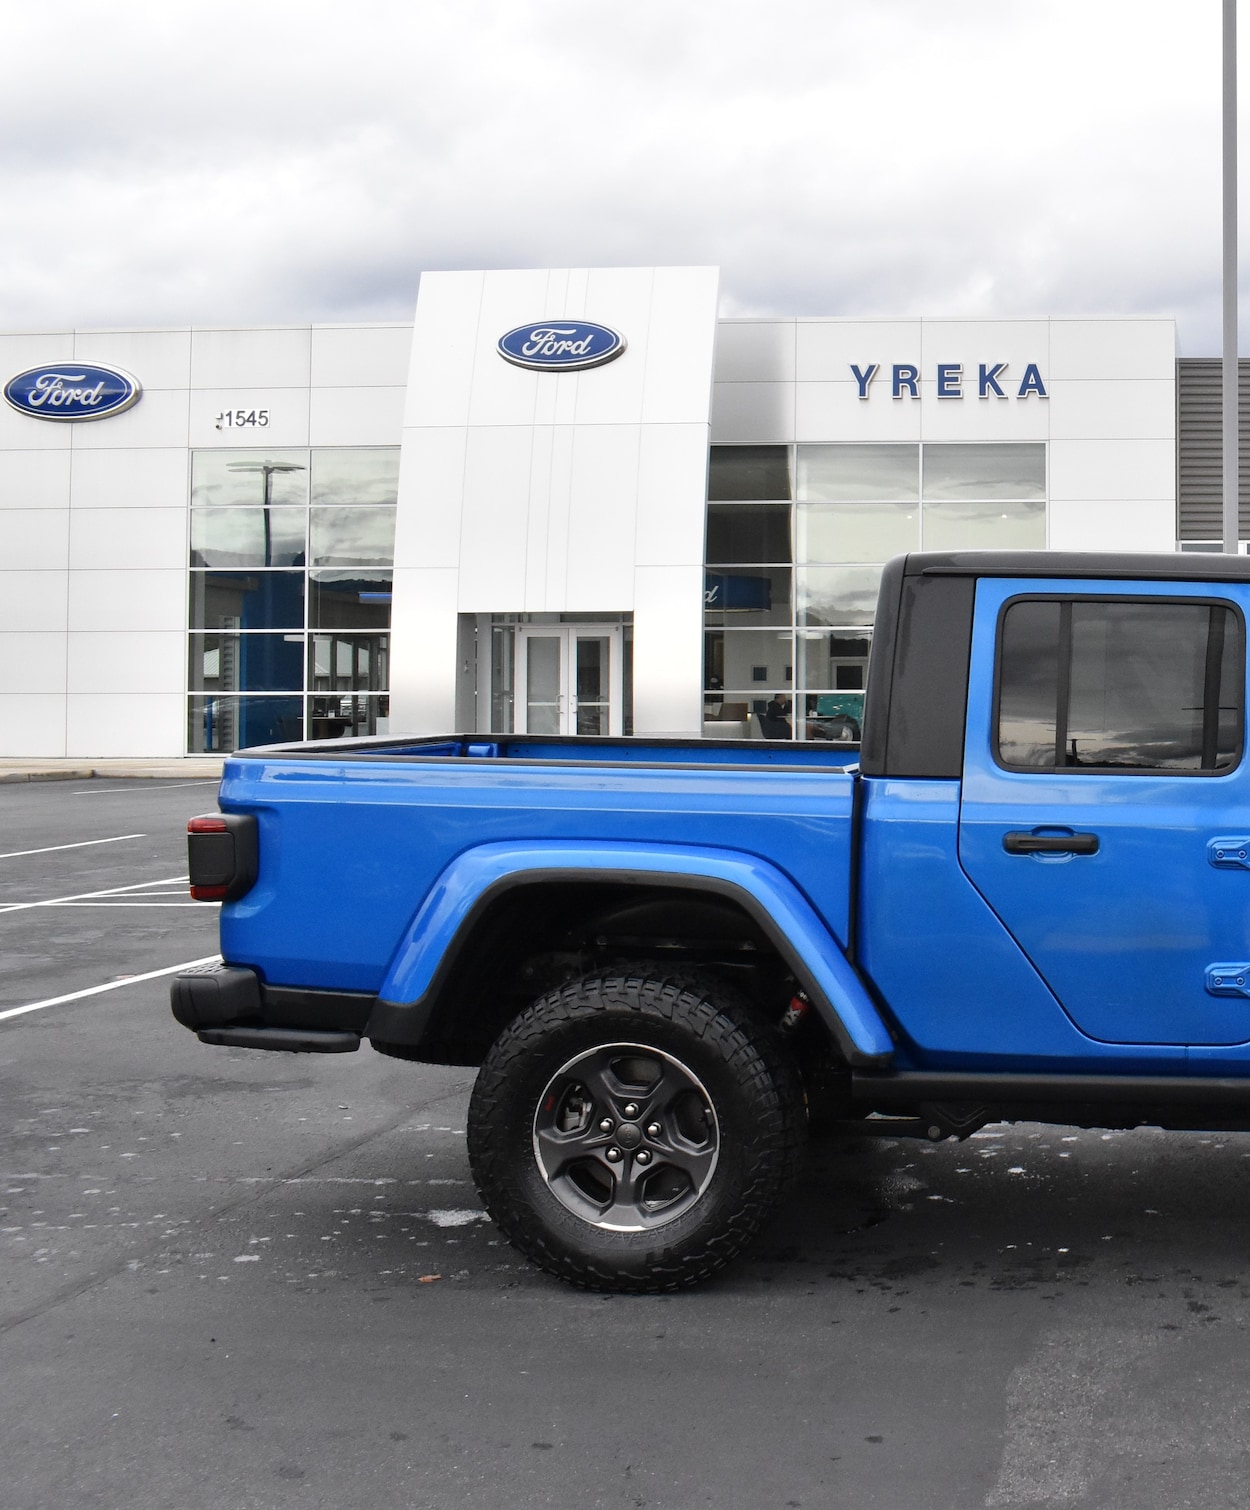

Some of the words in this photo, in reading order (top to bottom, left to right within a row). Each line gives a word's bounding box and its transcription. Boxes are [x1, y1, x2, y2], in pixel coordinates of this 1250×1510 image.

[522, 328, 594, 355] Ford
[28, 373, 105, 406] Ford
[849, 363, 1049, 400] YREKA
[225, 410, 269, 427] 1545
